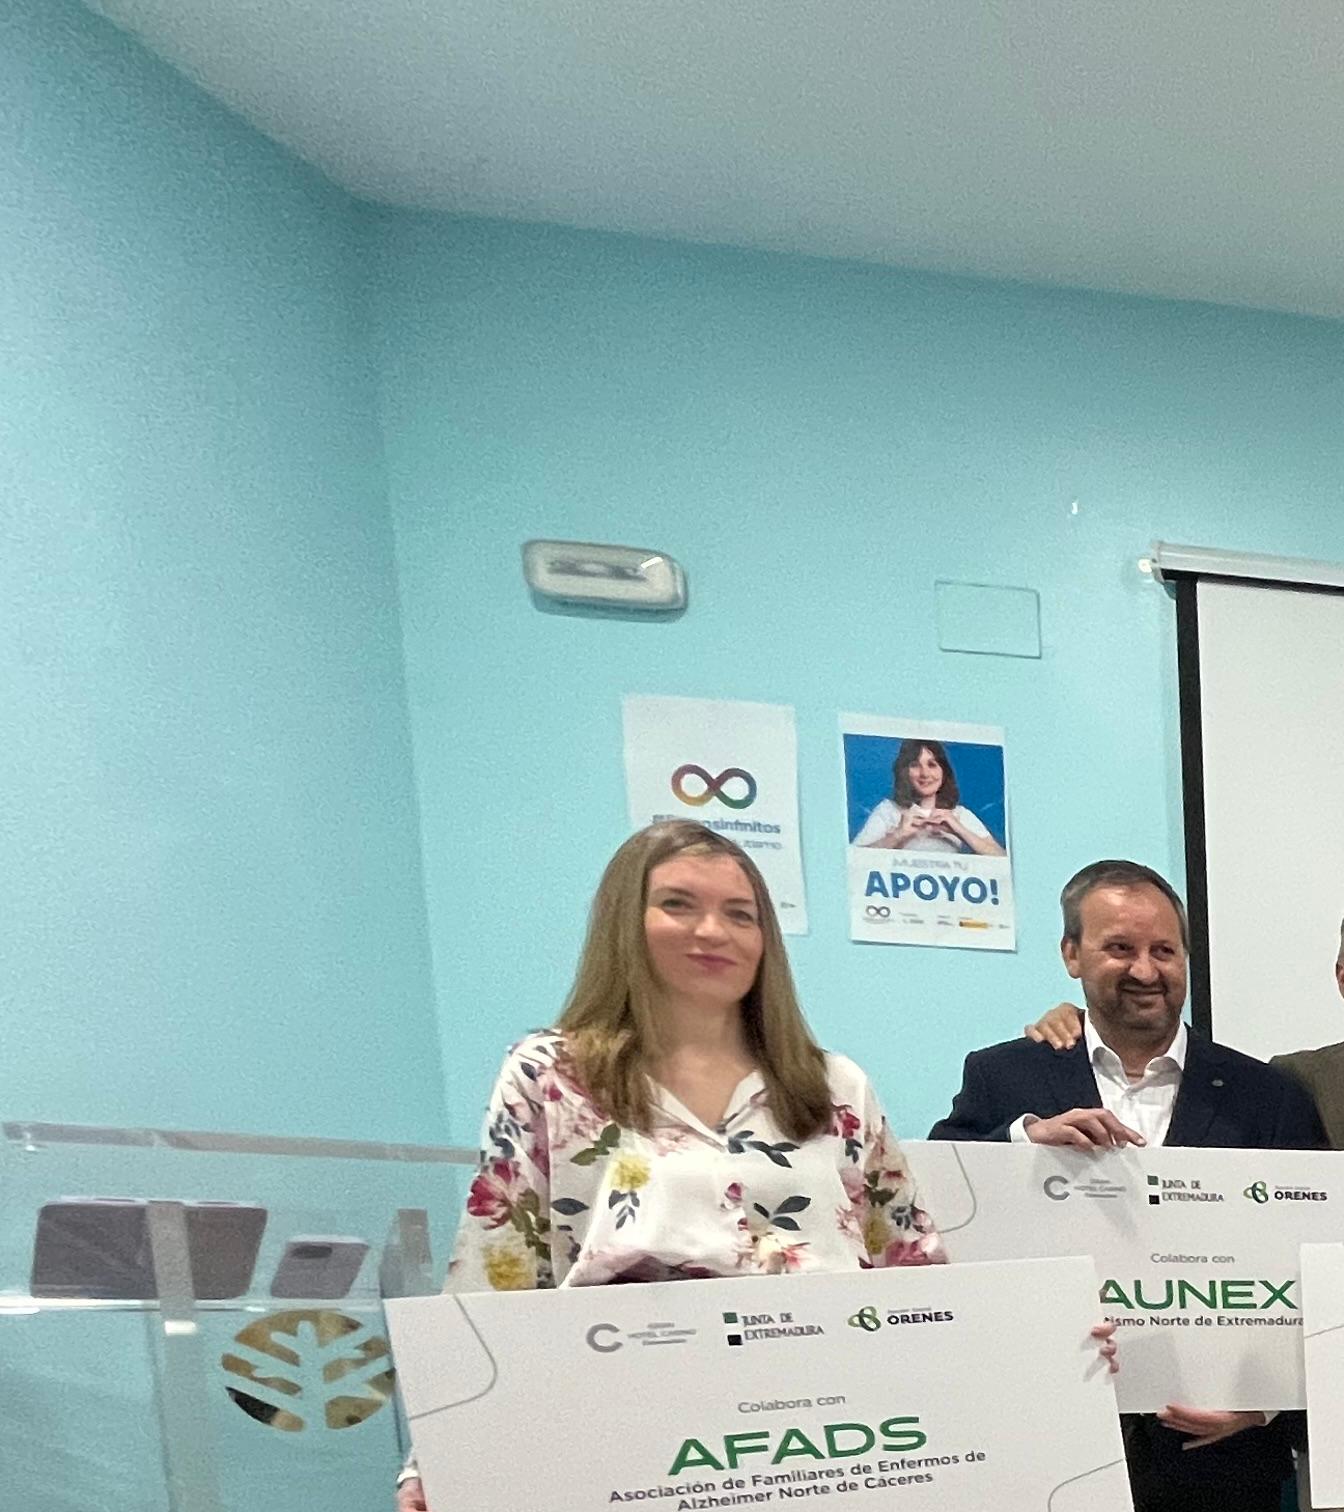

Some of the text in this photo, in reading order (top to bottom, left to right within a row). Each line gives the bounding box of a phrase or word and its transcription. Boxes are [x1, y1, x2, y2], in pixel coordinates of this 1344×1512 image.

[865, 870, 1000, 906] APOYO!
[1190, 1180, 1202, 1190] DE
[1162, 1191, 1225, 1203] EXTREMADURA
[1273, 1190, 1328, 1202] ORENES
[1150, 1253, 1235, 1264] Colabora con
[1098, 1279, 1299, 1310] AUNEX
[779, 1311, 794, 1324] DE
[886, 1310, 955, 1326] ORENES
[1149, 1315, 1190, 1327] Norte
[1194, 1315, 1213, 1327] de
[744, 1324, 826, 1342] EXTREMADURA
[737, 1393, 847, 1415] Colabora con
[667, 1415, 928, 1476] AFADS
[608, 1449, 987, 1504] Asociación de Familiares de Enfermos de
[677, 1471, 935, 1512] Alzheimer Norte de Cáceres
